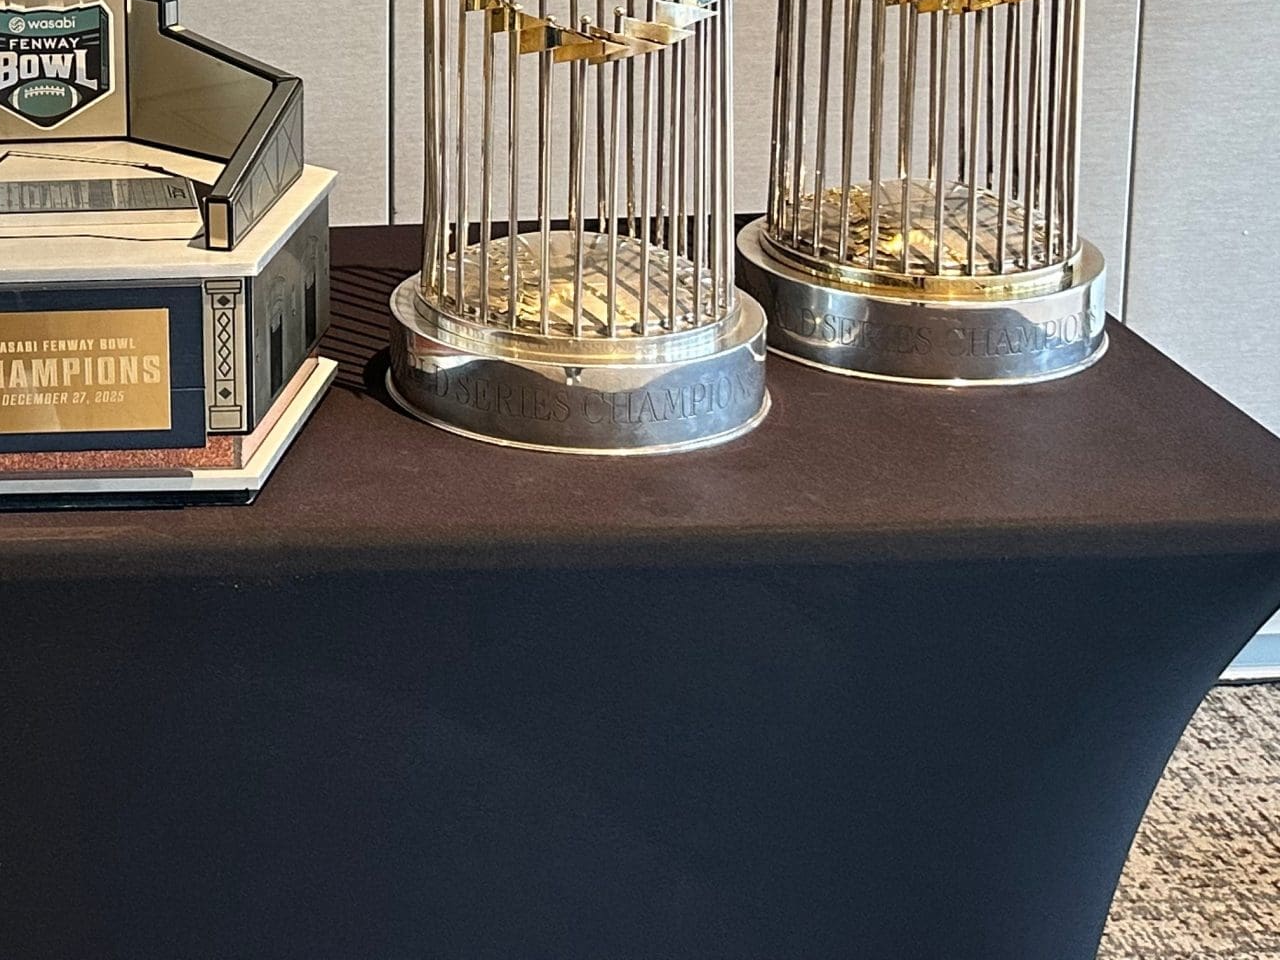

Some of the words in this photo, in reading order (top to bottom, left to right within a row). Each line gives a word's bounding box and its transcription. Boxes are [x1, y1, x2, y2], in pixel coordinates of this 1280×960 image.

[27, 15, 77, 29] wasabi
[9, 38, 80, 50] FENWAY
[42, 339, 94, 352] FENWAY
[100, 337, 136, 350] BOWL
[2, 392, 68, 407] DECEMBER
[72, 391, 90, 405] 27,
[94, 391, 125, 403] 2025
[455, 373, 571, 423] SERIES
